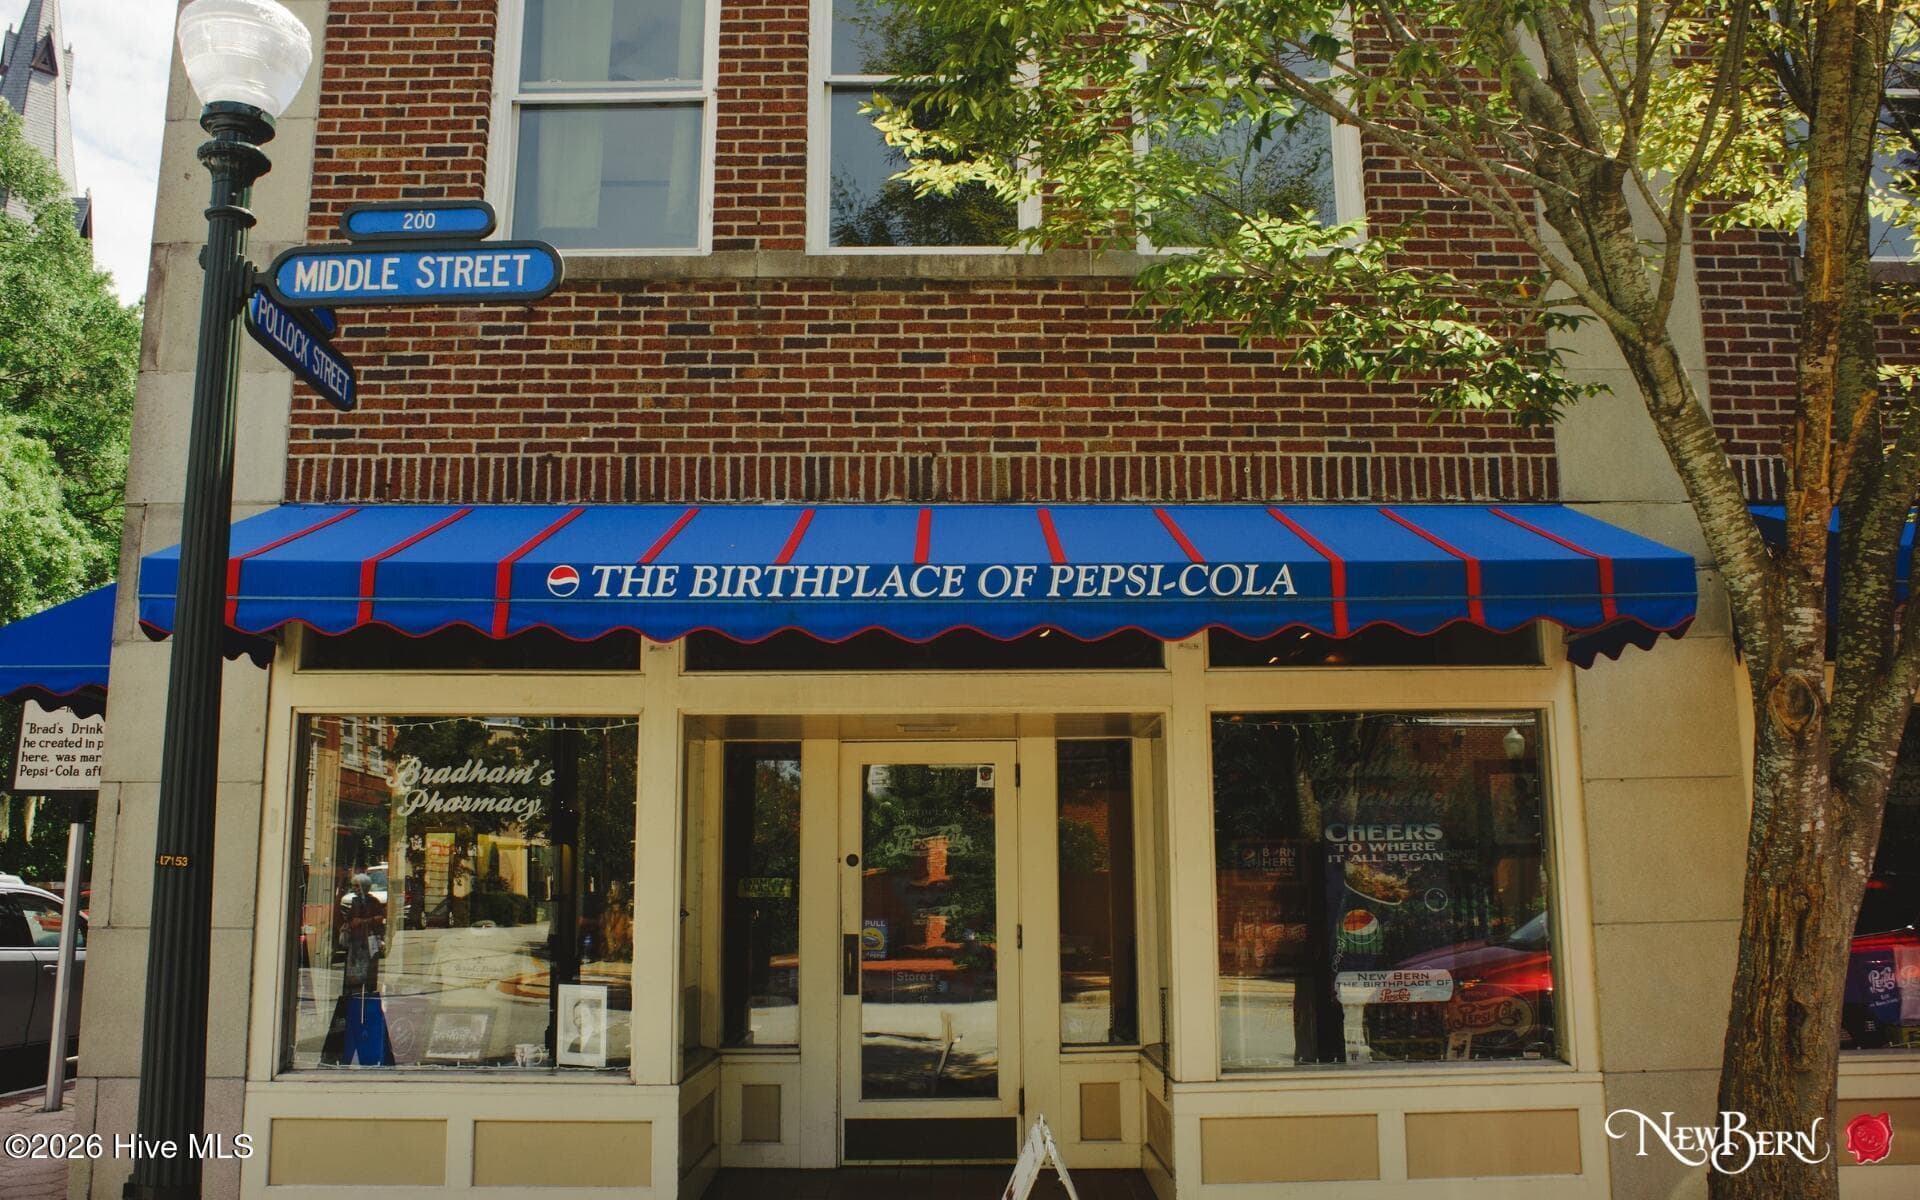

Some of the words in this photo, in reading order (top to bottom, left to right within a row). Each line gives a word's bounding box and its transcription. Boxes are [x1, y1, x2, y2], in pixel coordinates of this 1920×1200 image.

[402, 212, 436, 230] 200
[294, 257, 400, 293] MIDDLE
[415, 254, 531, 289] STREET
[257, 294, 309, 367] POLLOCK
[312, 344, 350, 401] STREET
[592, 564, 680, 597] THE
[689, 564, 966, 598] BIRTHPLACE
[977, 564, 1037, 598] OF
[1046, 563, 1298, 597] PEPSI-COLA
[22, 737, 37, 748] he
[38, 737, 82, 748] created
[85, 738, 95, 748] in
[56, 754, 77, 762] was
[19, 764, 80, 778] Pepsi-Cola
[386, 755, 556, 788] Bradham's
[397, 788, 542, 822] Pharmacy
[1325, 823, 1444, 842] CHEERS
[1335, 842, 1363, 852] TO
[1369, 842, 1436, 852] WHERE
[1262, 857, 1296, 867] HERE
[1327, 854, 1345, 863] IT
[1350, 854, 1382, 863] ALL
[1387, 853, 1444, 862] BEGAN
[864, 919, 886, 927] PULL
[896, 971, 927, 982] Store
[1357, 972, 1388, 981] NEW
[1393, 971, 1430, 980] BERN
[1363, 980, 1432, 988] BIRTHPLACE
